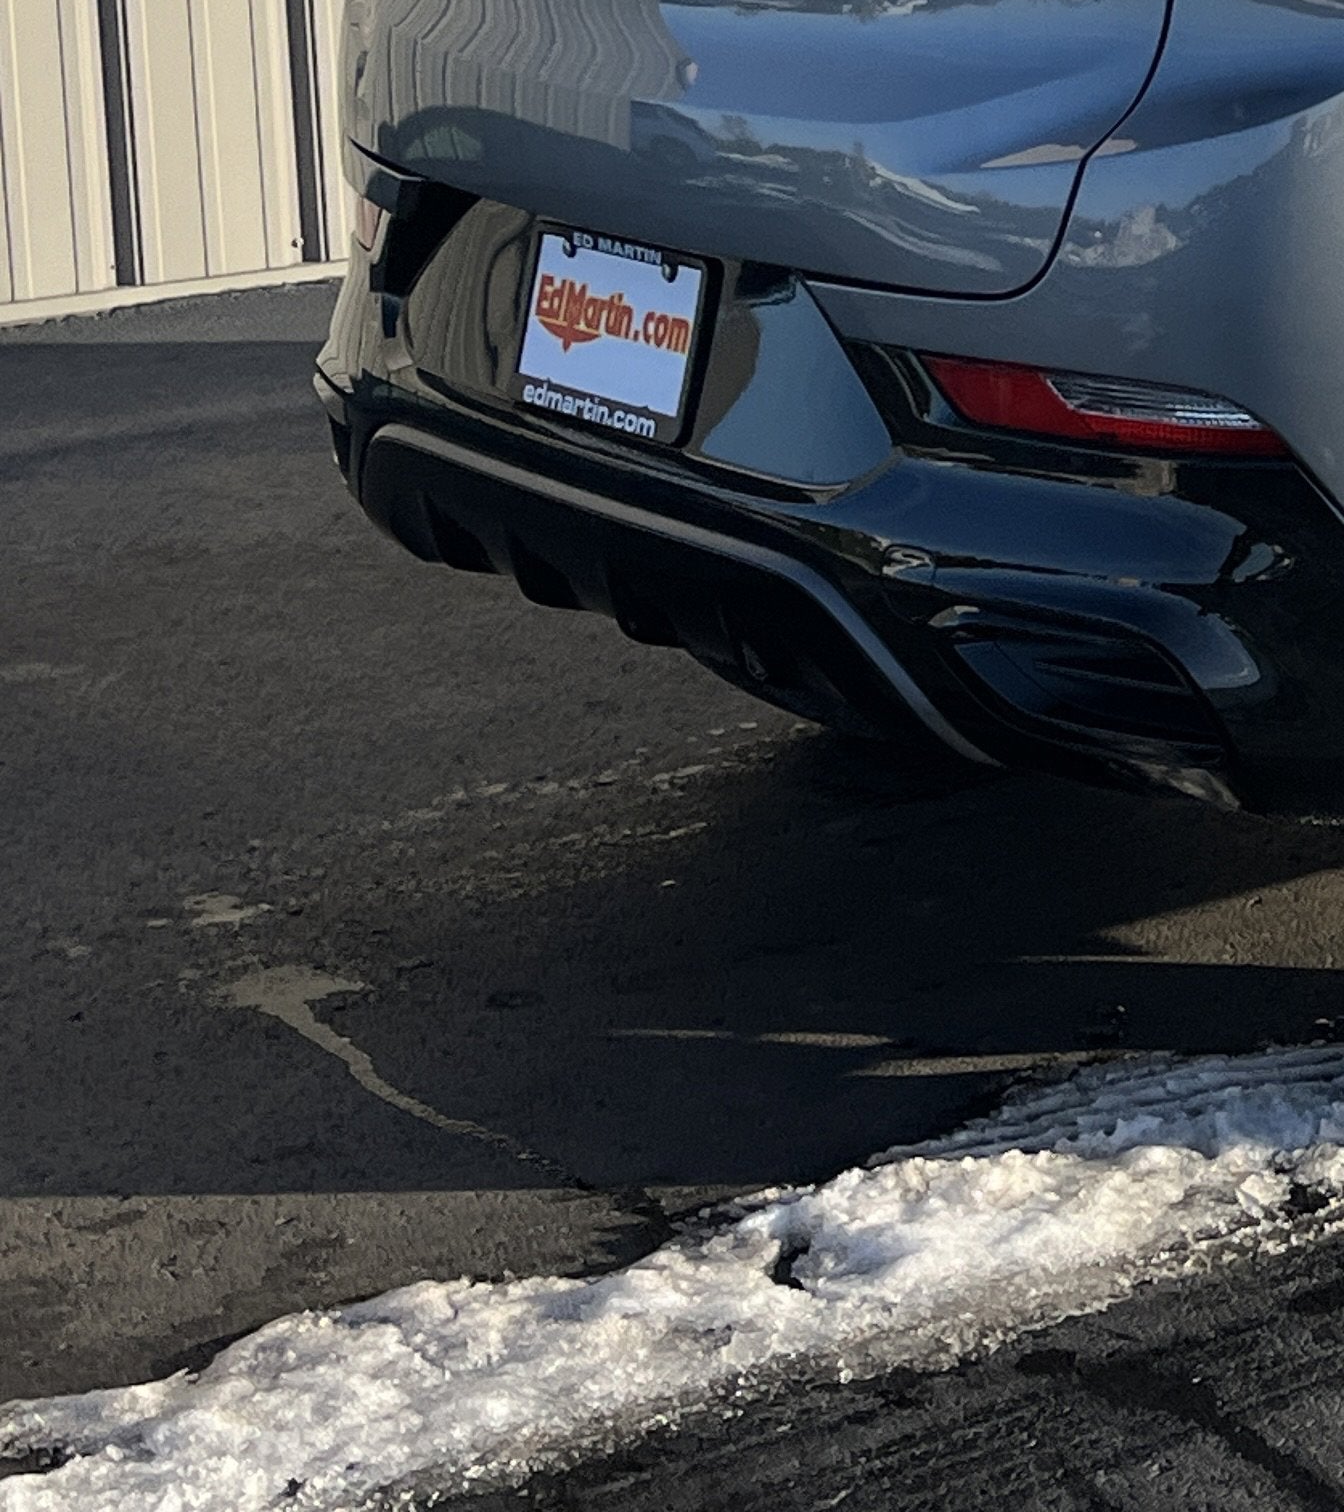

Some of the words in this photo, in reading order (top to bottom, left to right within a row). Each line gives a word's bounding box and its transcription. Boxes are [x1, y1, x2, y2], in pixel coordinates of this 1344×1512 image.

[573, 231, 594, 248] ED
[598, 237, 662, 265] MARTIN
[535, 273, 690, 353] EdMartin.com
[523, 383, 657, 438] edmartin.com
